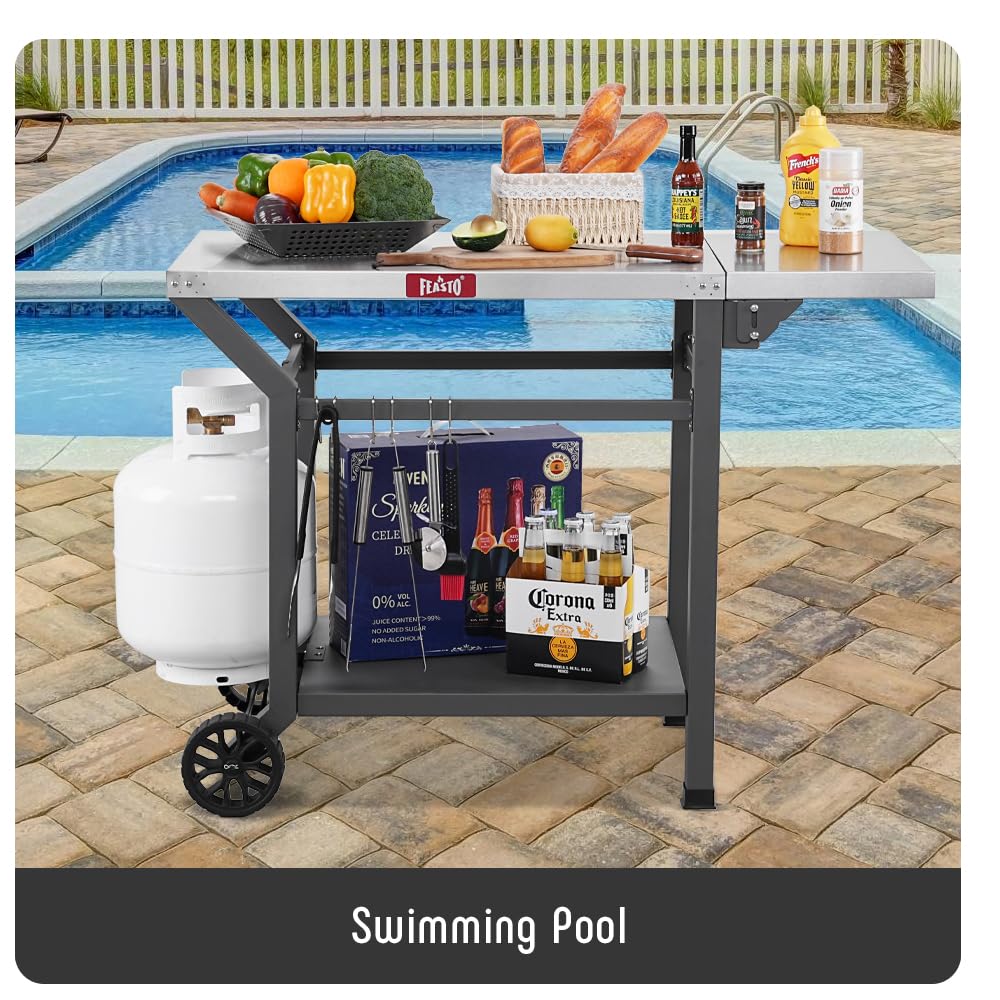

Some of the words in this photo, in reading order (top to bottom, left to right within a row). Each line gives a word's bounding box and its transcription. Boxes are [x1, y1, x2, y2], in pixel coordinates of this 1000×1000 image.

[789, 156, 820, 171] French's
[792, 181, 815, 191] YELLOW
[830, 200, 852, 208] Onion
[406, 470, 429, 485] VEN
[469, 582, 488, 592] HEAVE
[372, 595, 396, 609] 0%
[528, 588, 595, 611] Corona
[547, 607, 582, 623] Extra
[382, 626, 404, 634] ADDED
